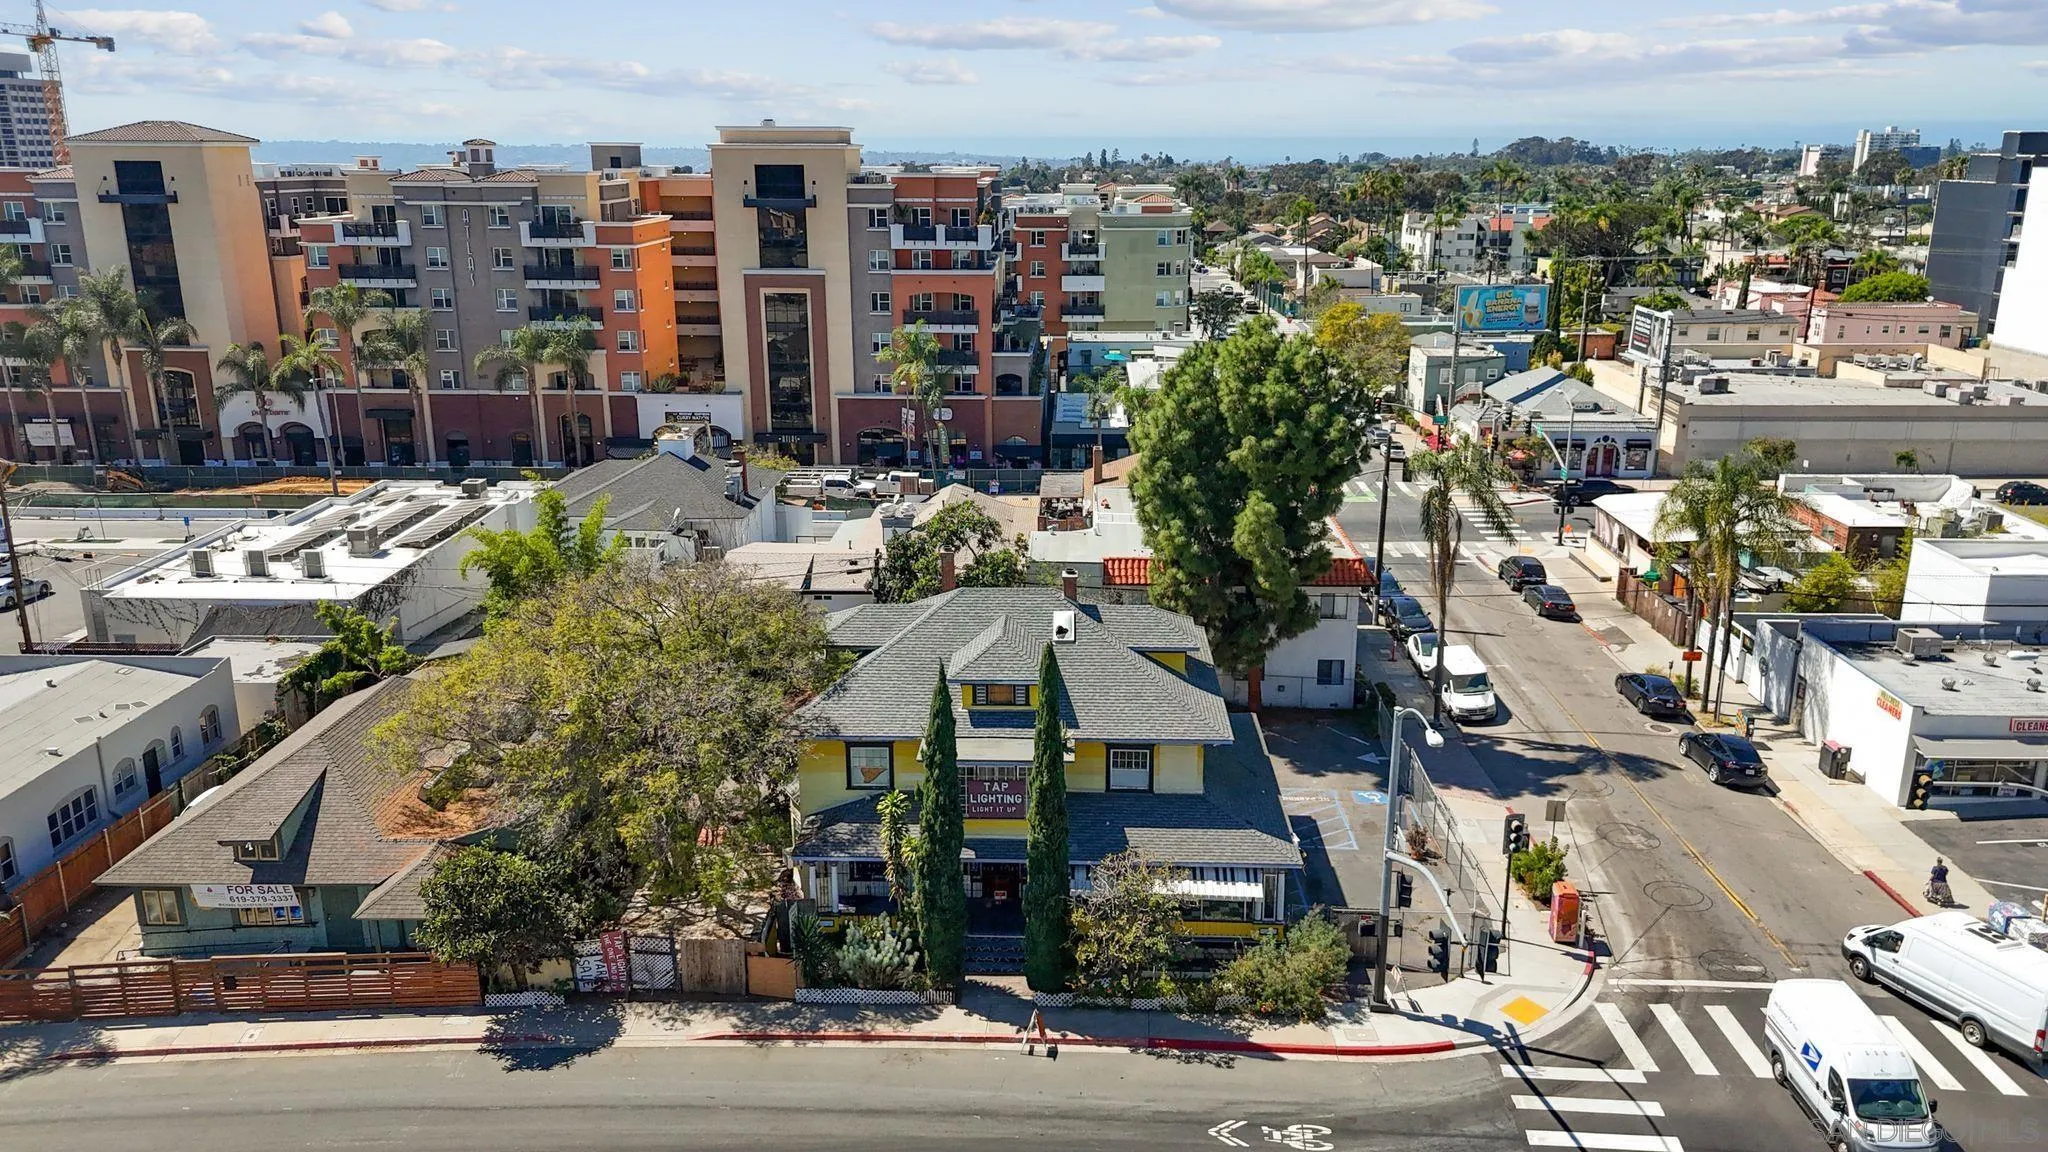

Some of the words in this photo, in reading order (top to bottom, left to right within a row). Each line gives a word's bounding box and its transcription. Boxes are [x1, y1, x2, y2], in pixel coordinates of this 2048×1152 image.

[462, 208, 475, 287] ATLAS
[1496, 290, 1513, 299] BIG
[1876, 696, 1902, 721] CLEANERS
[983, 782, 1009, 792] TAP
[970, 793, 1022, 804] LIGHTING
[226, 885, 255, 895] FOR
[257, 885, 293, 895] SALE
[229, 894, 294, 903] 619-379-3337
[602, 934, 612, 945] THE
[607, 947, 615, 960] ONE
[613, 934, 623, 950] TAP
[578, 959, 594, 988] SALE
